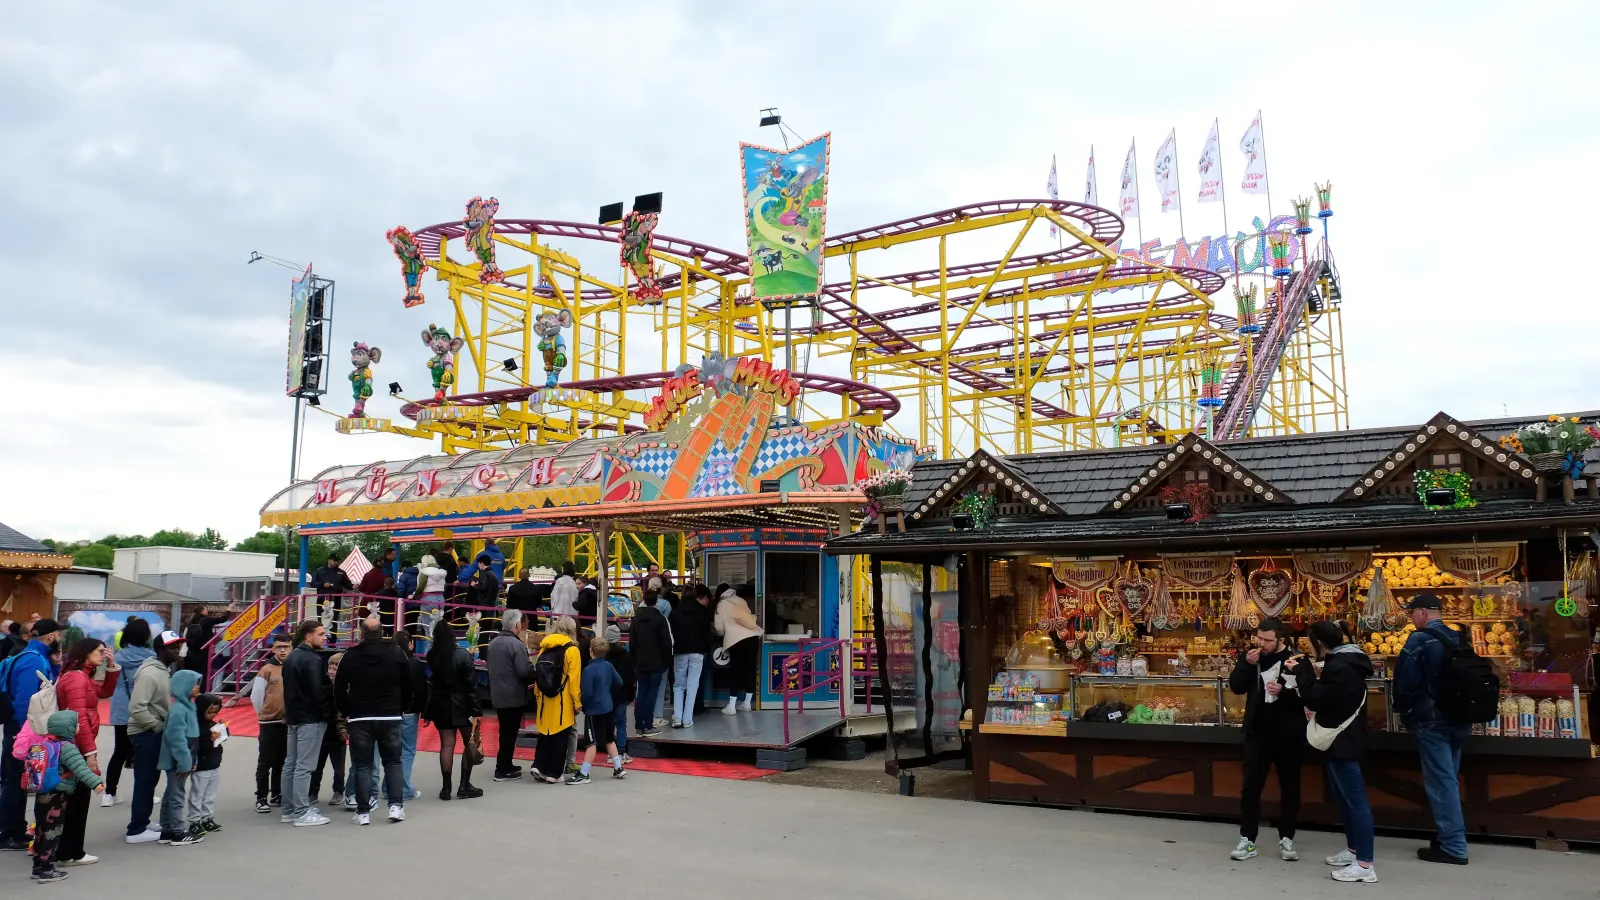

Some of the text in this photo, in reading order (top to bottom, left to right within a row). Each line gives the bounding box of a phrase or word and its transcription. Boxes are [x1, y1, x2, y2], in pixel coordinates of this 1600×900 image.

[1172, 214, 1300, 274] MAUS
[731, 356, 801, 408] MAUS
[1310, 558, 1356, 575] Erdnüsse
[1450, 555, 1499, 571] Mandeln
[1064, 567, 1106, 583] Magenbrot
[1183, 569, 1213, 581] Herzen
[229, 611, 256, 638] AUSGANG
[258, 609, 285, 636] AUSGANG
